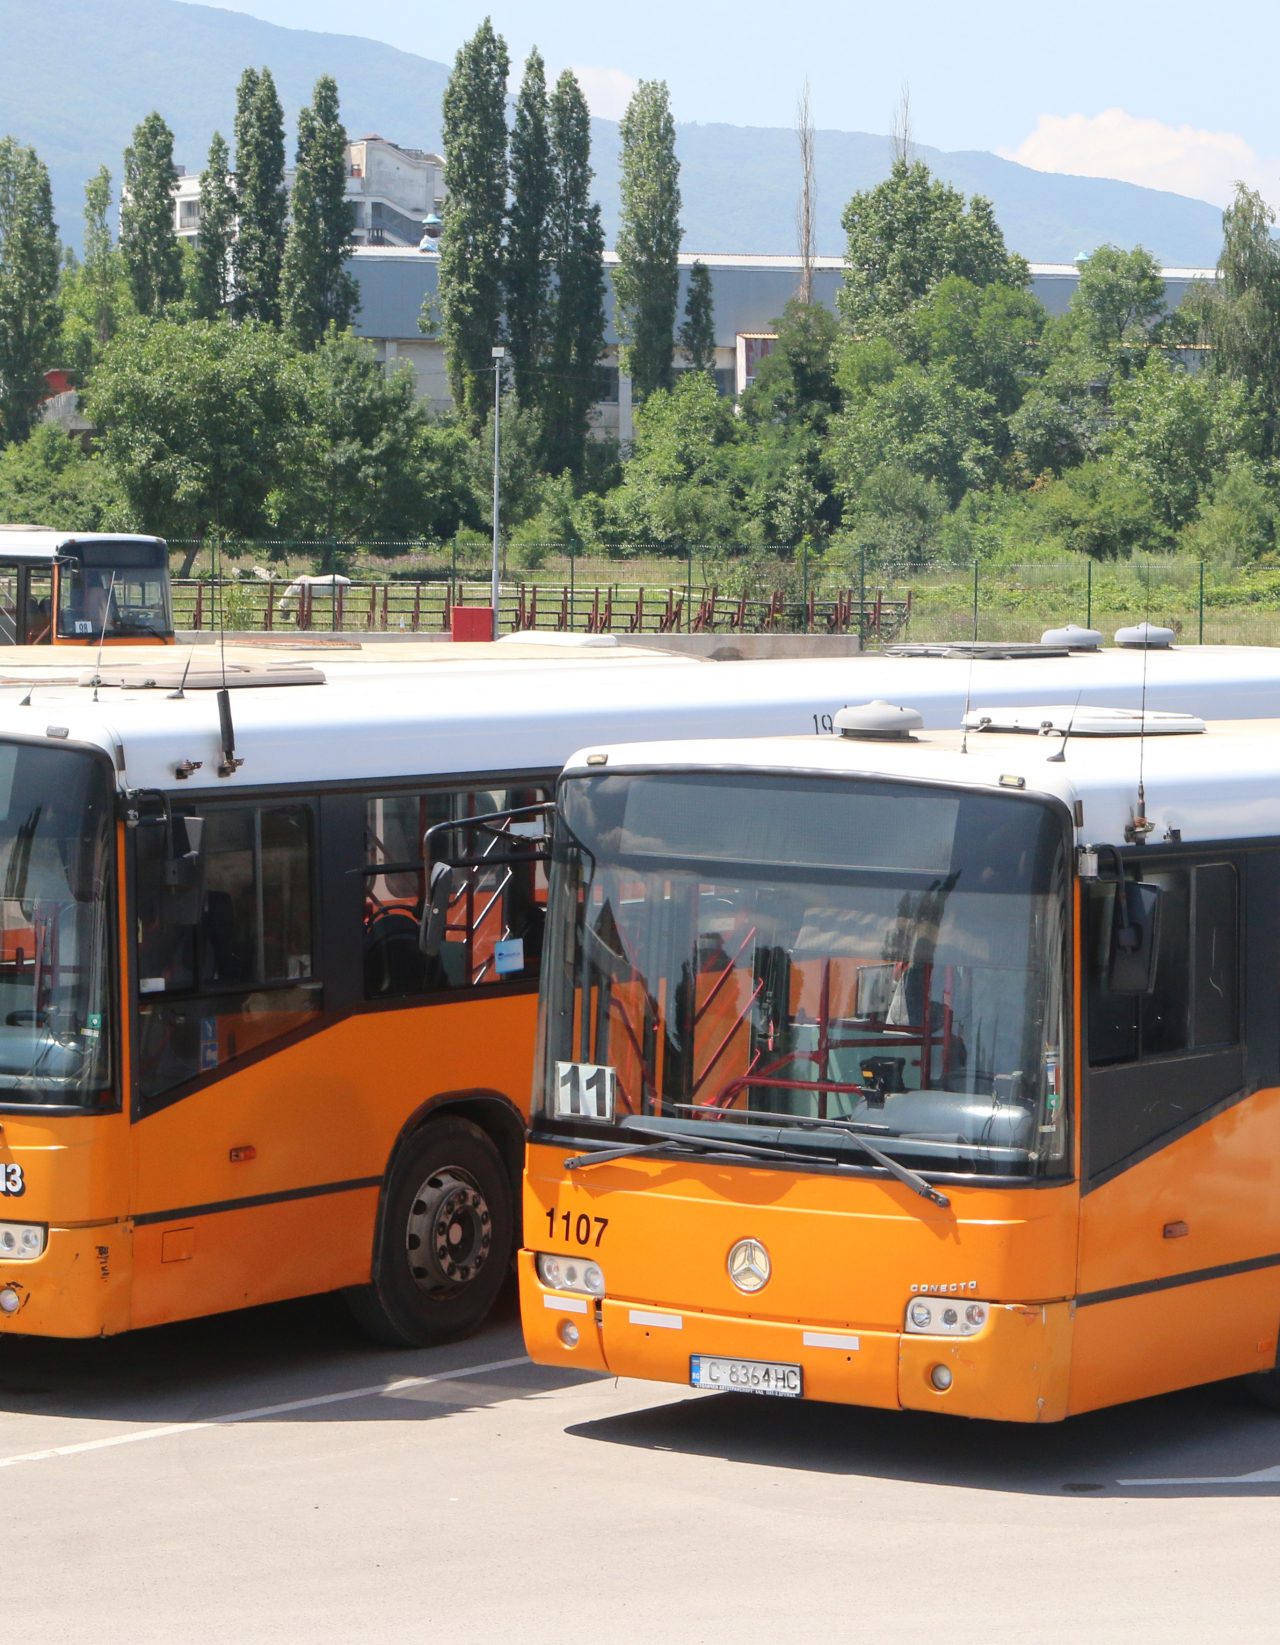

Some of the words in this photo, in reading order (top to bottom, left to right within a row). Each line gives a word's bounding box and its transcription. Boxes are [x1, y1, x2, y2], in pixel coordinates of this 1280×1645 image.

[560, 1065, 607, 1118] 11
[545, 1207, 609, 1248] 1107
[910, 1280, 977, 1293] CONECTO
